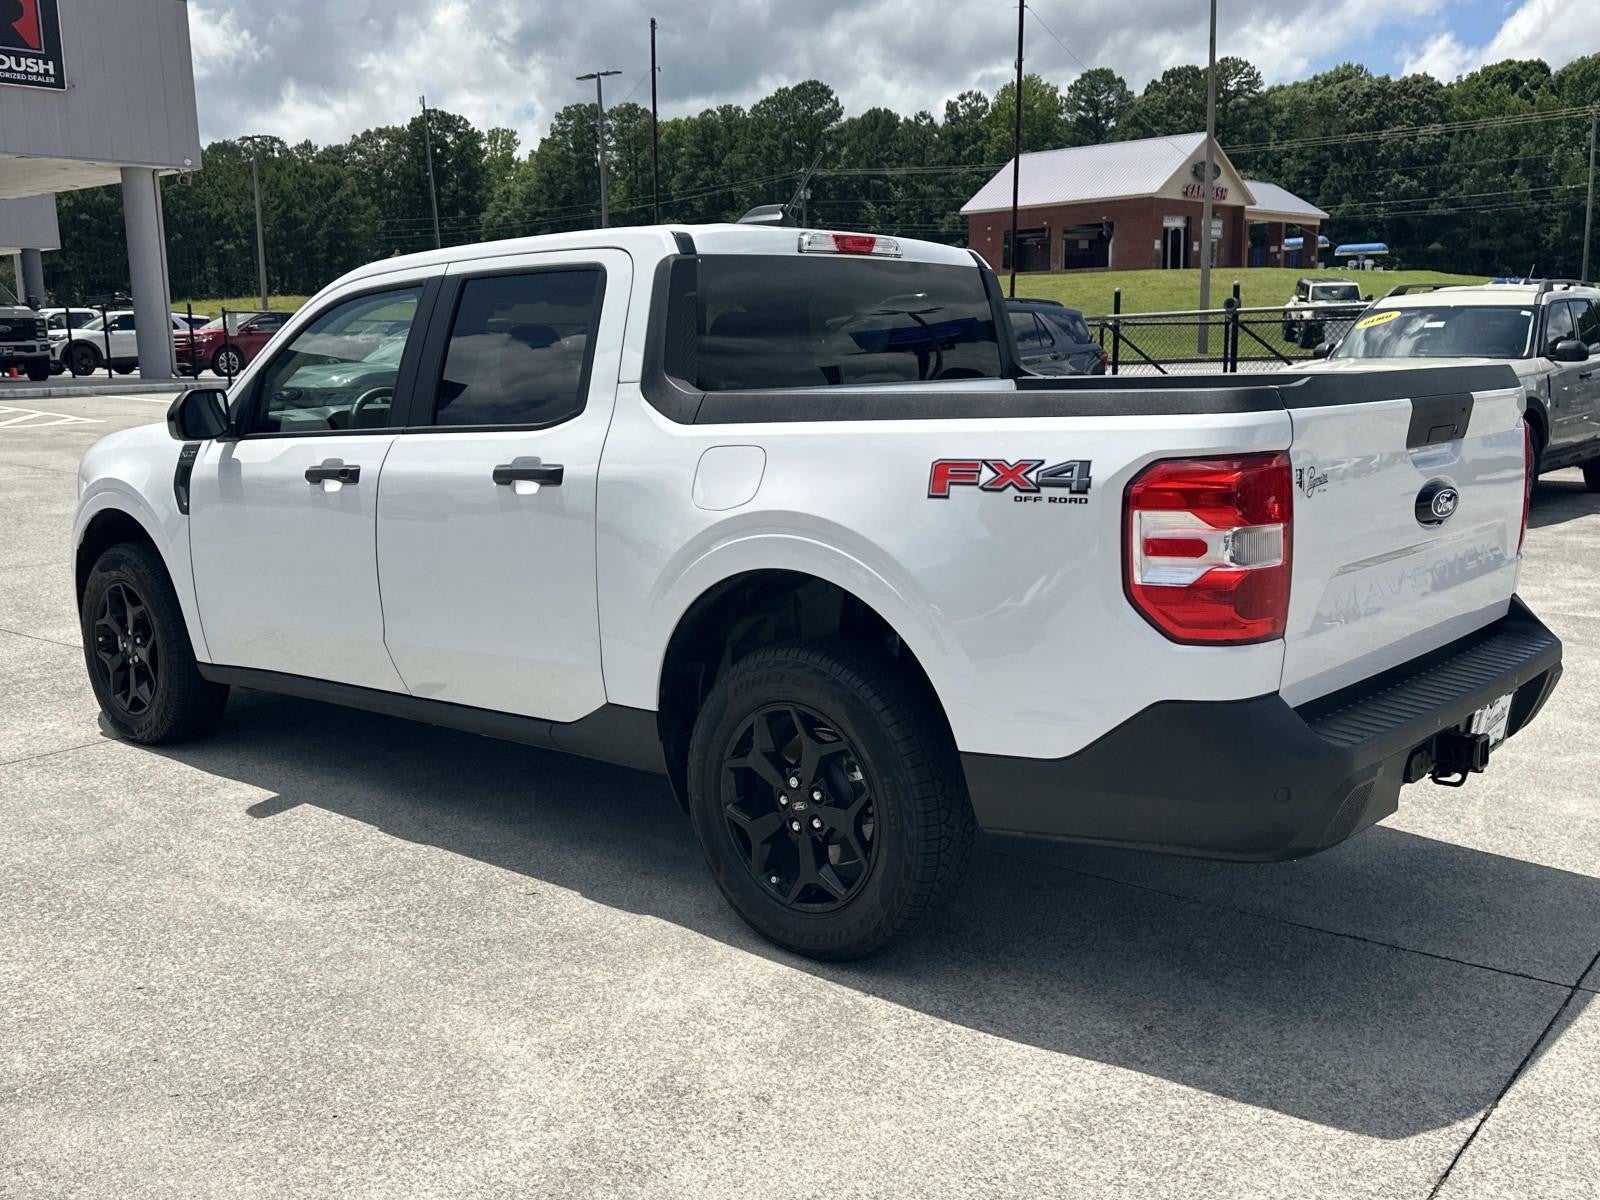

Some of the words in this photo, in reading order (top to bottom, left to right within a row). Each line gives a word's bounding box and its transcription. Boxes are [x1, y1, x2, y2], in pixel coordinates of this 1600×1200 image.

[0, 54, 54, 75] OUSH
[28, 74, 55, 83] DEALER
[927, 458, 1092, 499] FX4
[1014, 495, 1043, 503] OFF
[1048, 496, 1088, 504] ROAD
[1436, 492, 1457, 514] Ford
